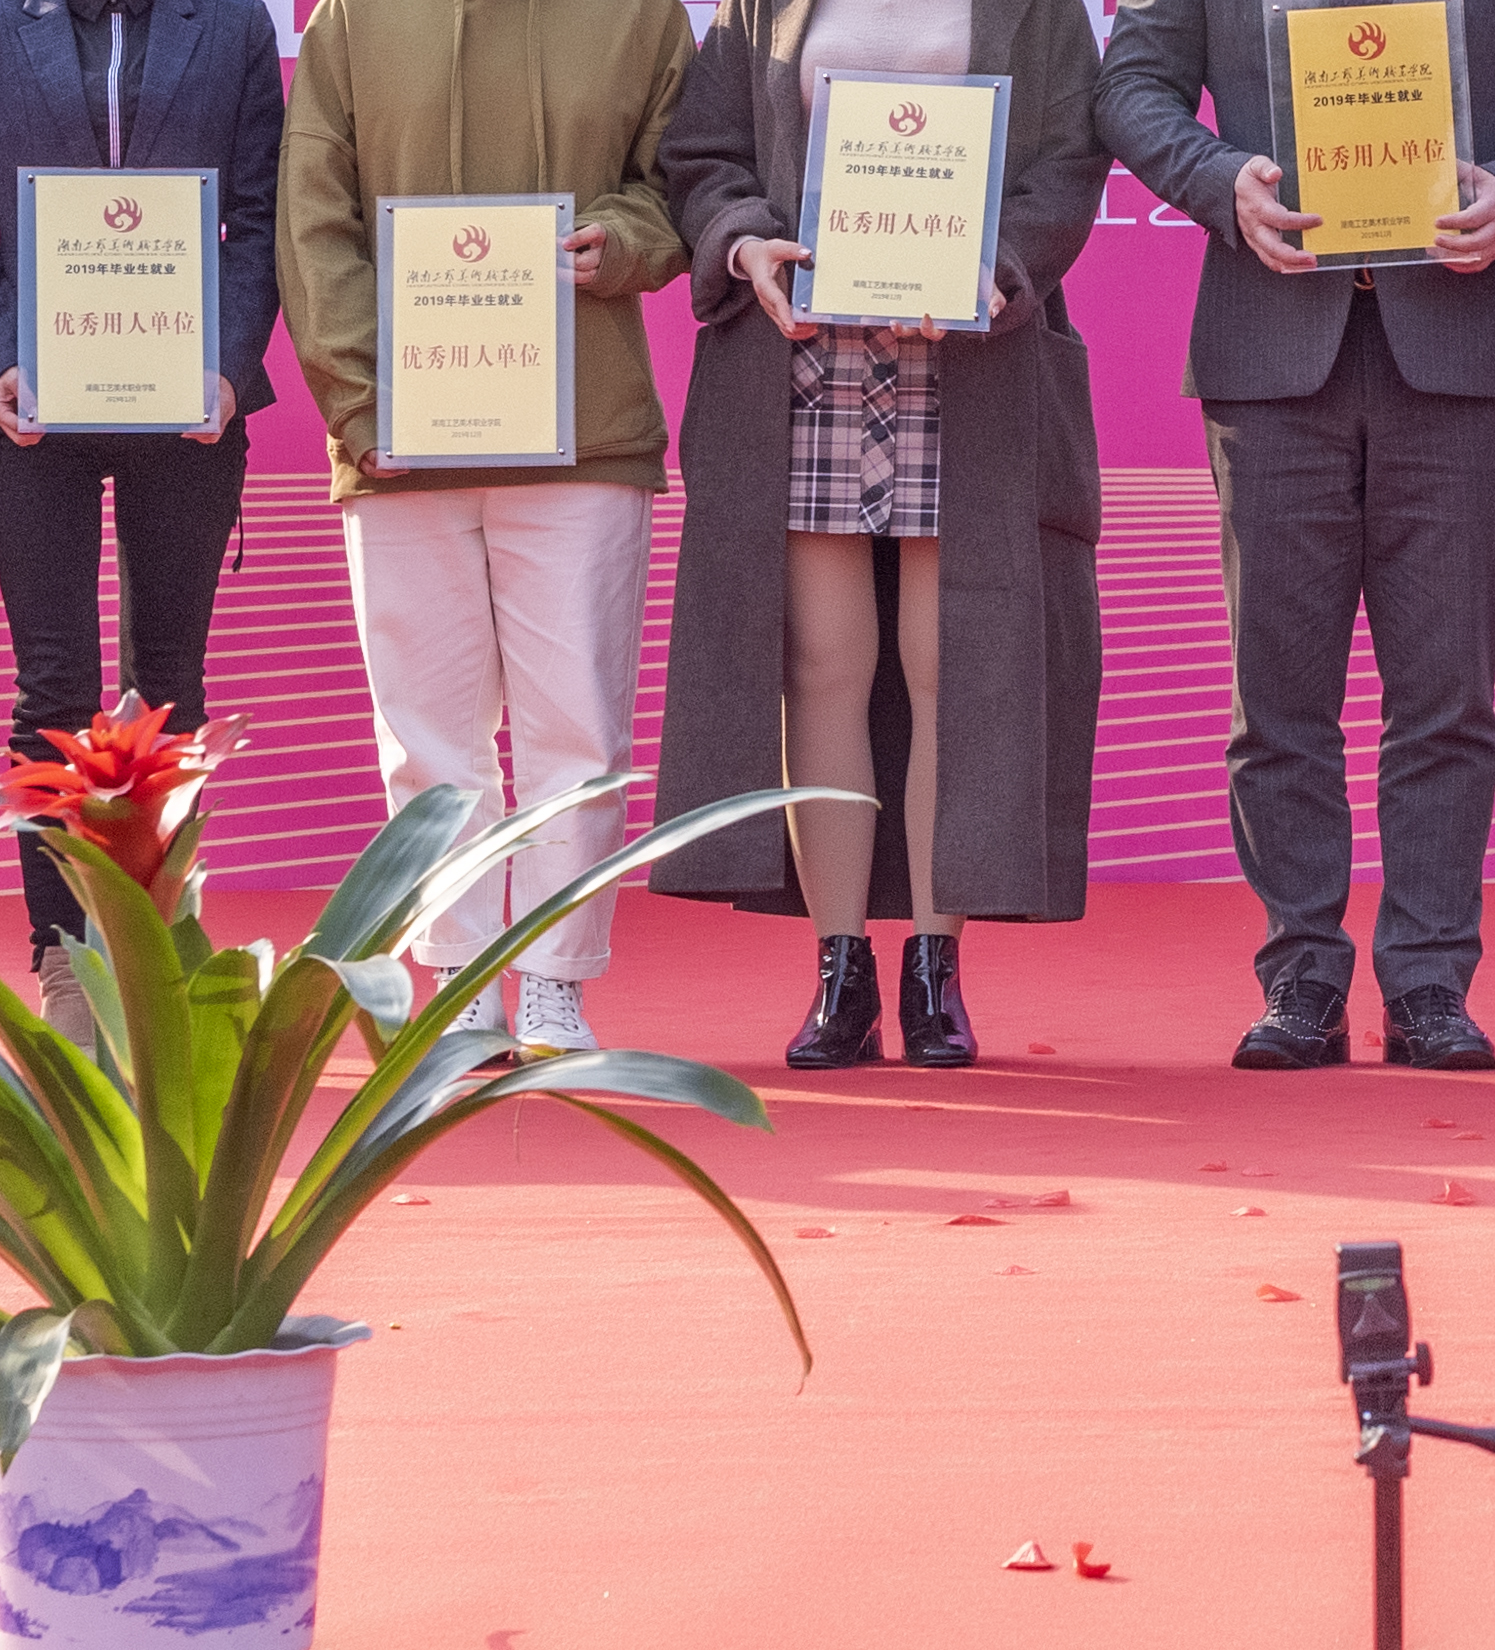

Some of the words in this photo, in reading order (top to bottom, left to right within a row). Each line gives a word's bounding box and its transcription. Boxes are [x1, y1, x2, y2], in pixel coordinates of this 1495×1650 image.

[1313, 89, 1423, 107] 2019年毕业生就业
[1305, 138, 1446, 172] 优秀用人单位
[845, 164, 954, 180] 2019年毕业生就业
[828, 209, 968, 238] 优秀用人单位
[65, 263, 176, 275] 2019年毕业生就业
[414, 294, 523, 307] 2019年毕业生就业
[54, 311, 195, 336] 优秀用人单位
[401, 343, 541, 370] 优秀用人单位
